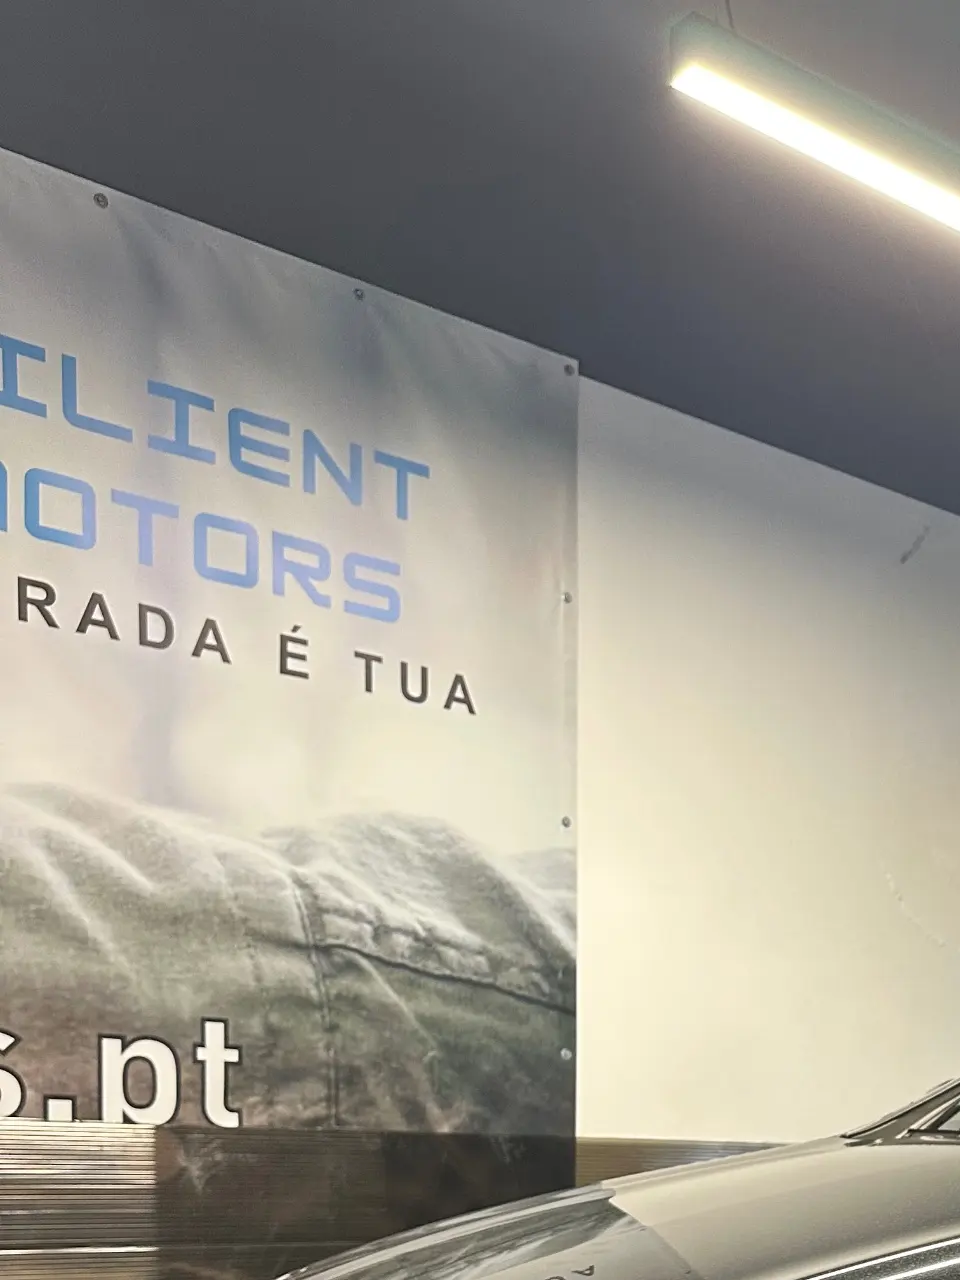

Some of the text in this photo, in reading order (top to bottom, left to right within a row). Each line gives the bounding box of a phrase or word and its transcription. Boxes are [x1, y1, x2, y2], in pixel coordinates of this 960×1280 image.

[0, 459, 401, 624] OTORS
[17, 575, 476, 715] RADA É TUA
